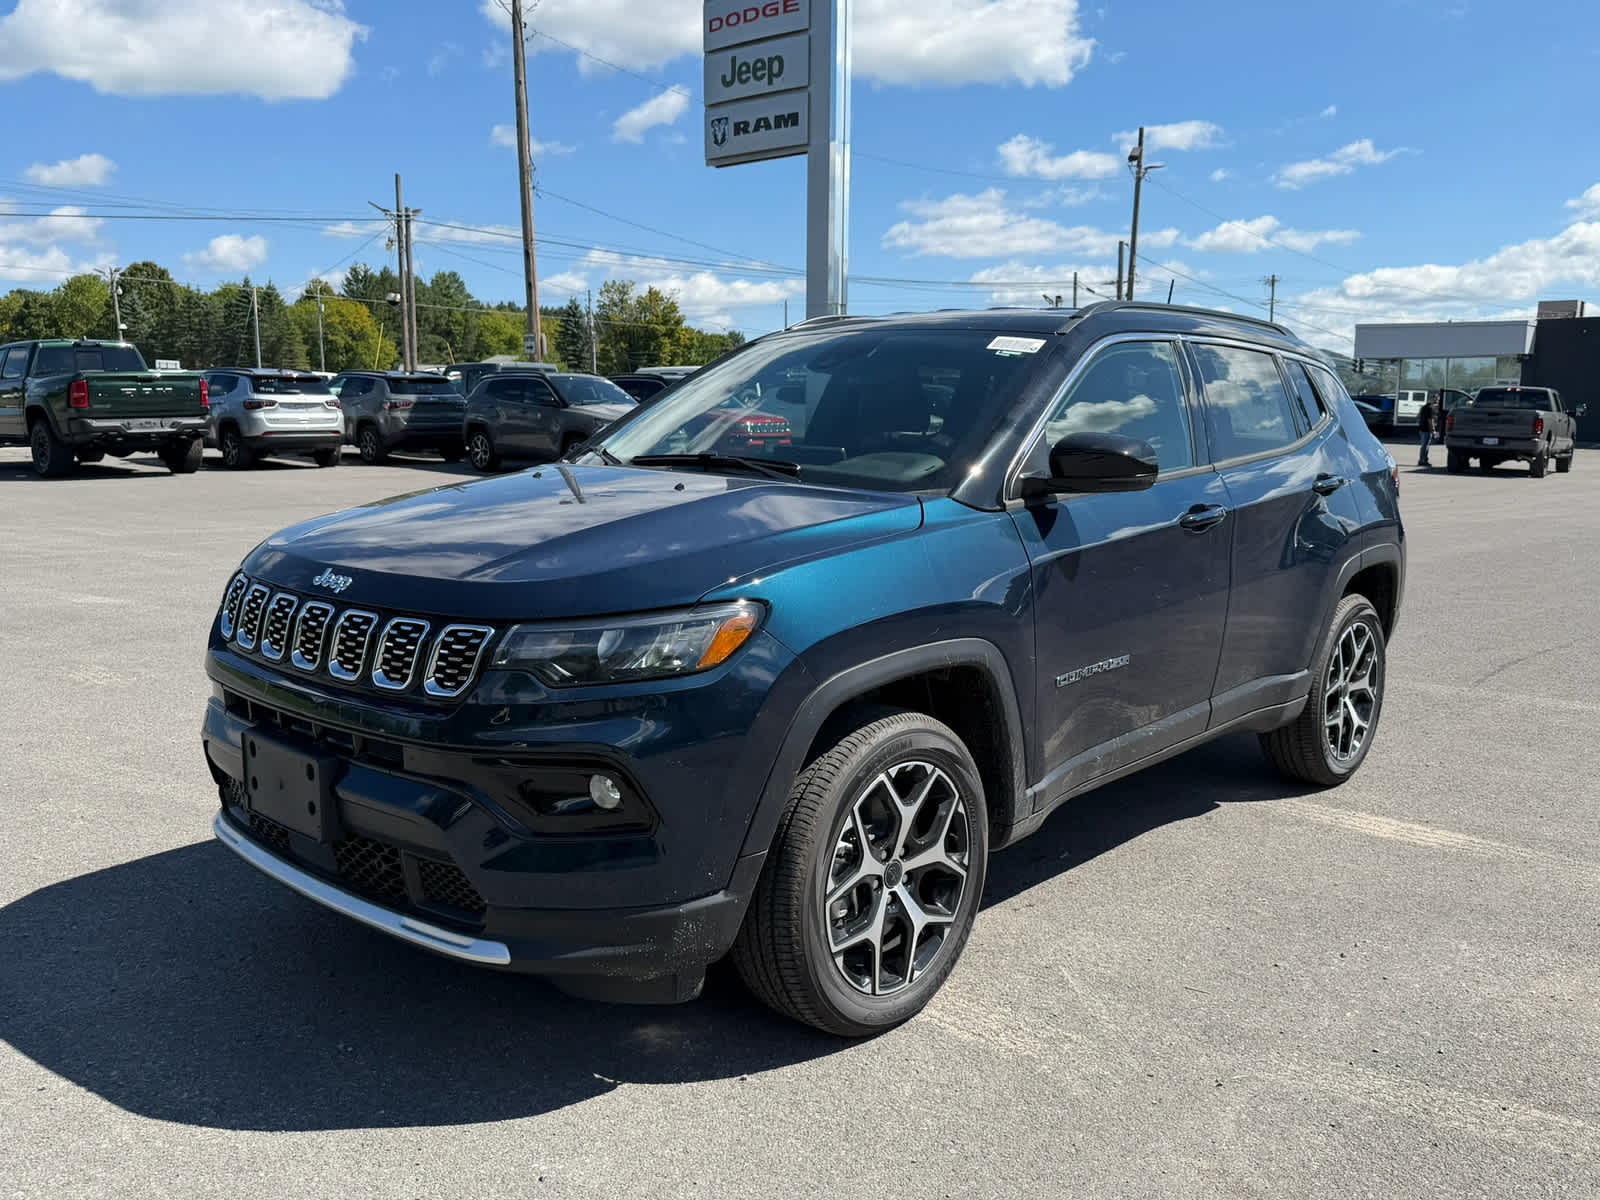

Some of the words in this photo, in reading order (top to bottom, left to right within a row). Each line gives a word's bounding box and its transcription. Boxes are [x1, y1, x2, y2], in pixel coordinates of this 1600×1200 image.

[709, 0, 800, 33] DODGE
[721, 54, 785, 88] Jeep
[733, 112, 800, 137] RAM
[313, 567, 353, 594] Jeep
